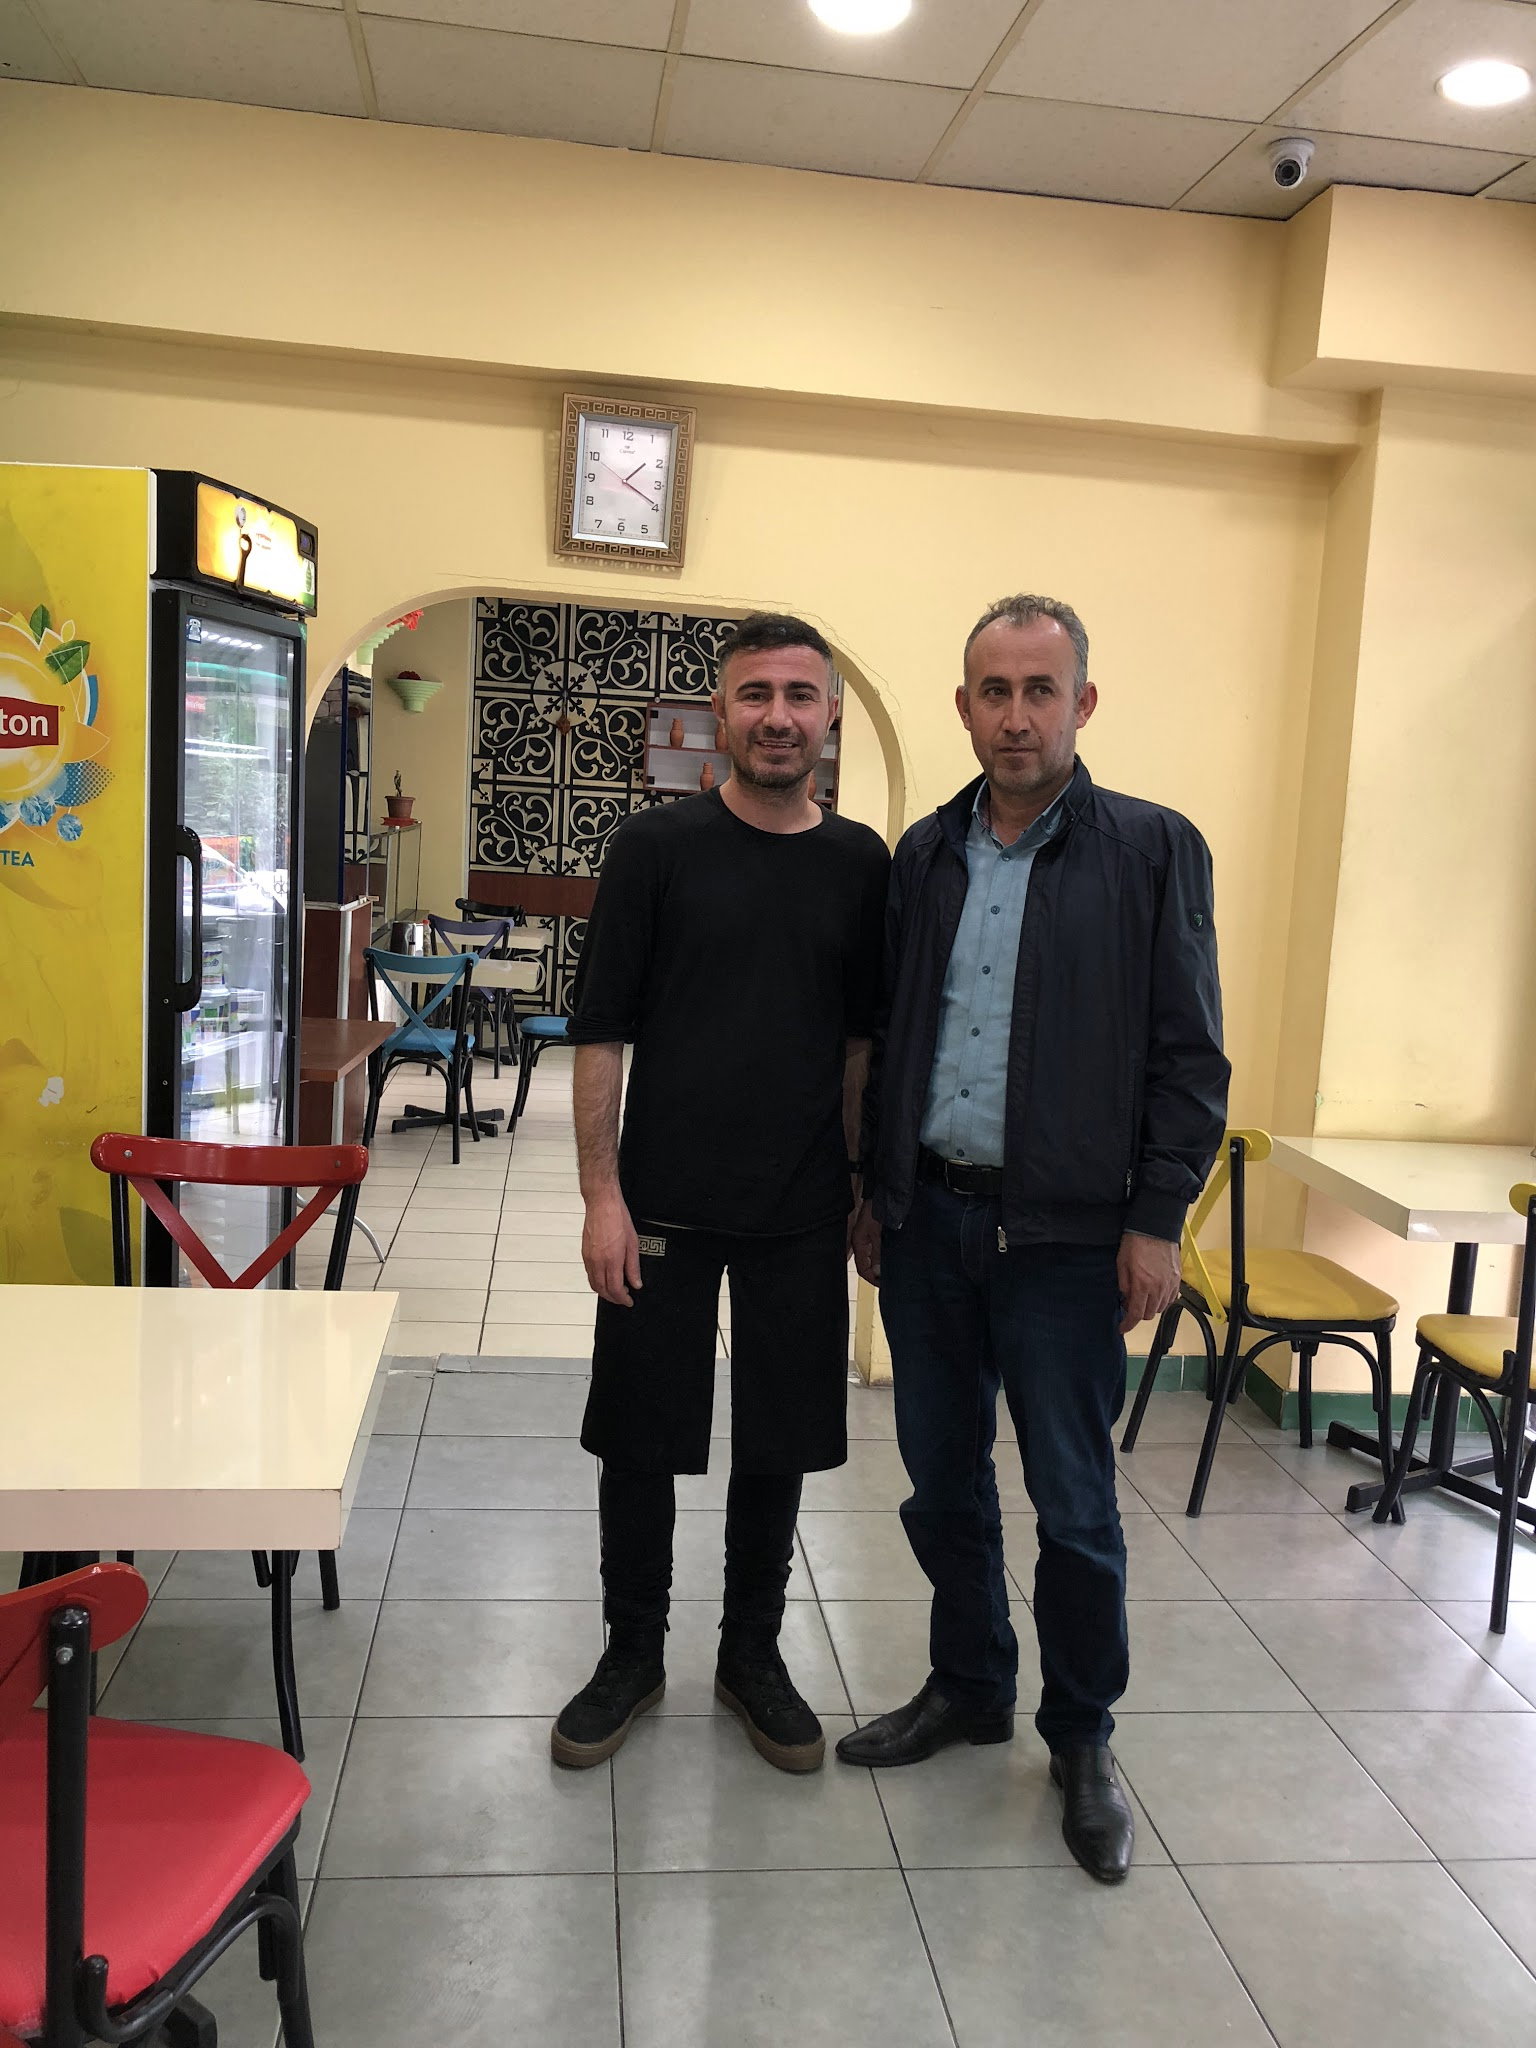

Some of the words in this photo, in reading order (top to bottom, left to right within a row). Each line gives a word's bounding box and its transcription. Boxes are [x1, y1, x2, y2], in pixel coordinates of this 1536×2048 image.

[601, 428, 609, 438] 11
[623, 430, 634, 441] 12
[589, 451, 600, 461] 10
[655, 459, 664, 469] 2
[587, 472, 595, 482] 9
[654, 481, 662, 490] 3
[585, 496, 594, 505] 8
[651, 503, 660, 512] 4
[594, 519, 603, 529] 7
[617, 522, 625, 532] 6
[641, 524, 649, 534] 5
[0, 708, 48, 736] ton
[0, 850, 35, 867] TEA
